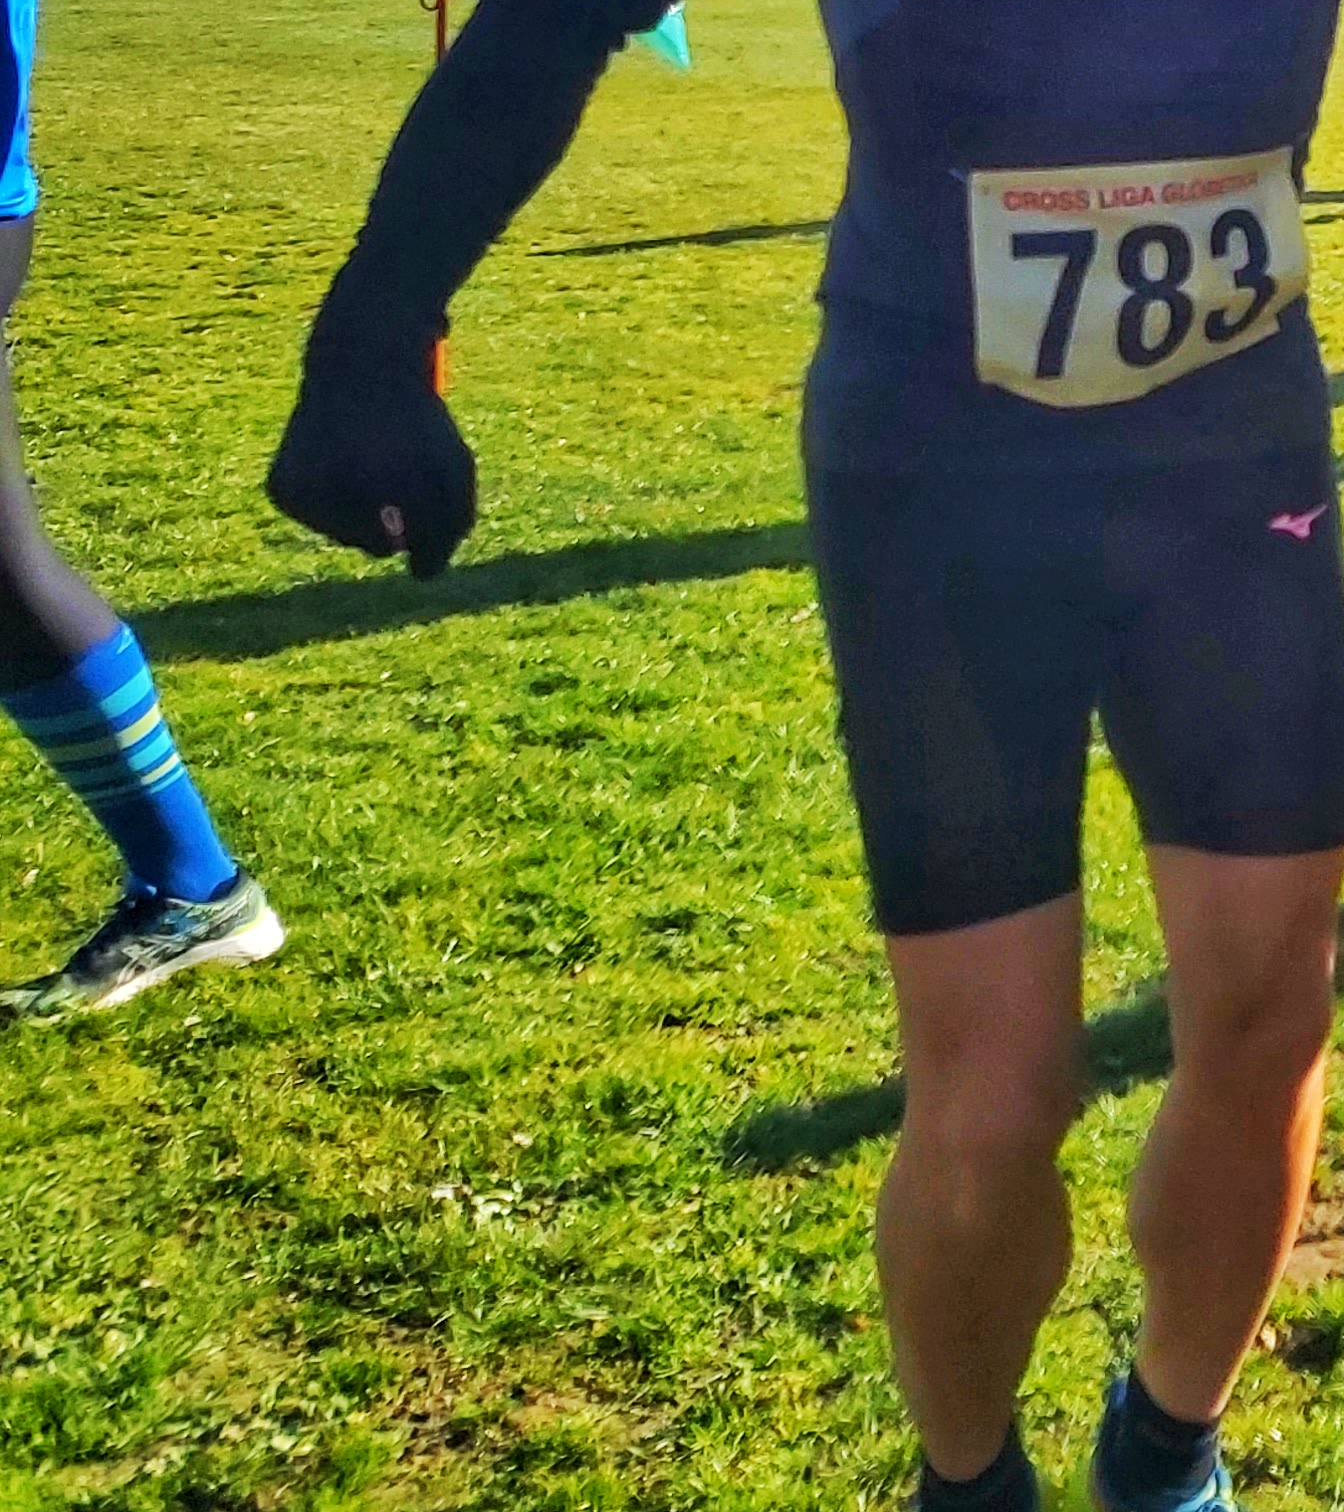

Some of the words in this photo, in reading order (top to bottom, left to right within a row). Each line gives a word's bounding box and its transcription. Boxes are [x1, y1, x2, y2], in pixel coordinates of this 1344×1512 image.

[1003, 188, 1090, 212] CROSS
[1098, 186, 1155, 209] LIGA
[1011, 208, 1276, 380] 783
